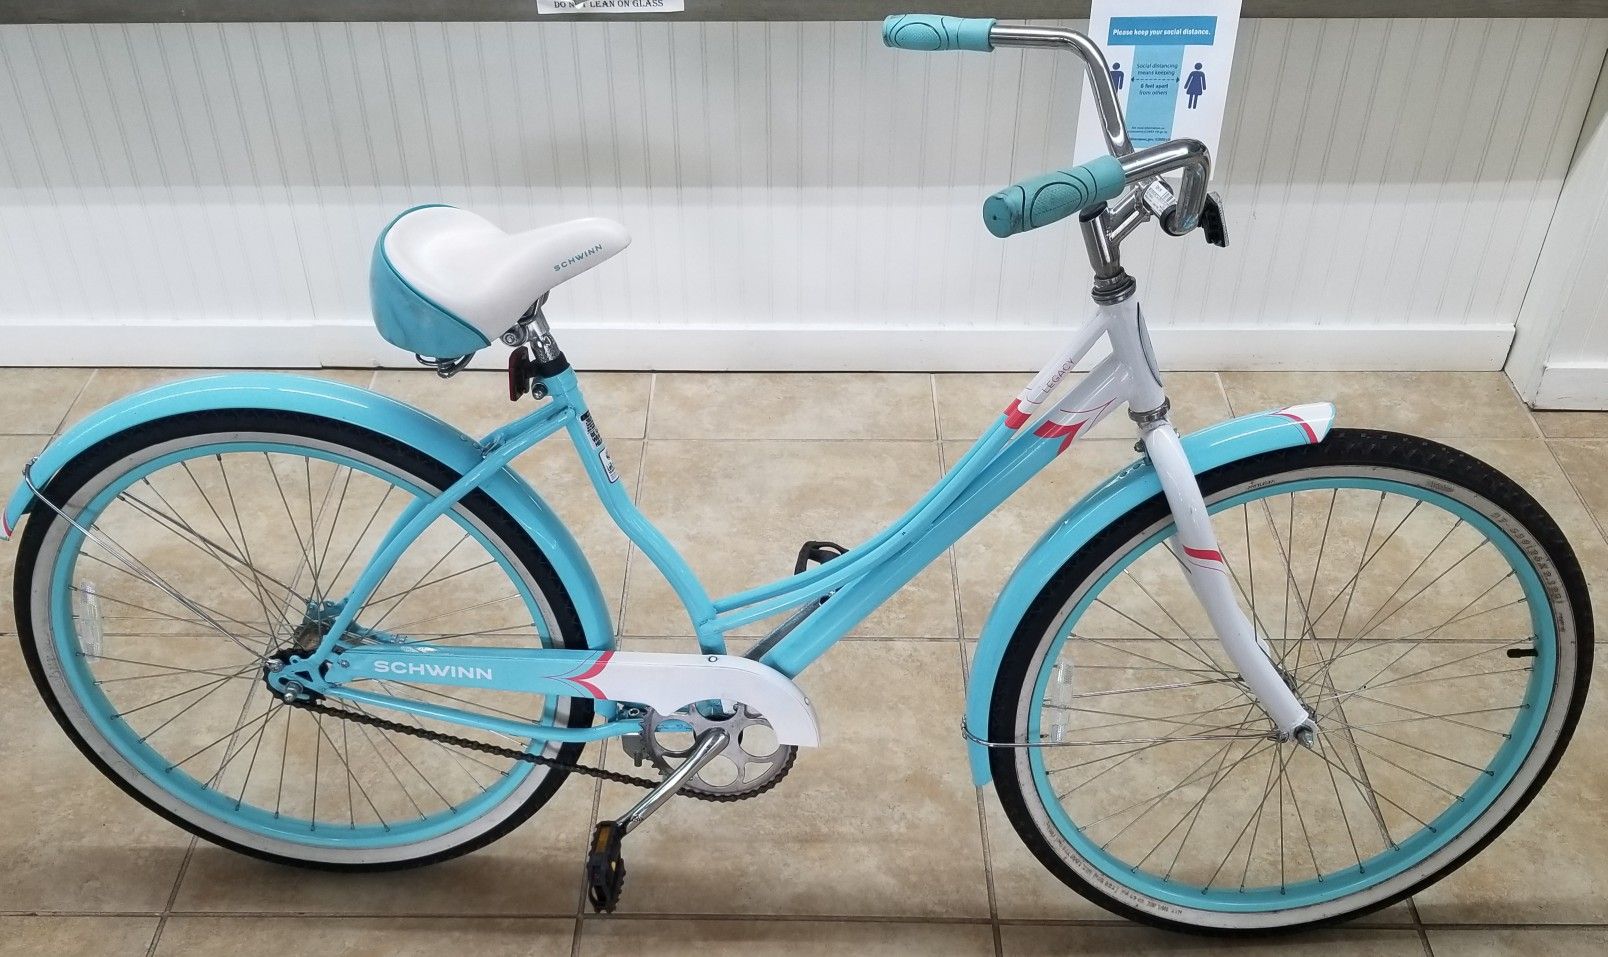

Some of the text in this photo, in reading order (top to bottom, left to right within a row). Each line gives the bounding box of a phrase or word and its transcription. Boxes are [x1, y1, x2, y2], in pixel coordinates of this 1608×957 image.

[590, 0, 615, 8] LEAN
[617, 0, 630, 8] ON
[1183, 28, 1211, 36] distance.
[553, 243, 603, 272] SCHWINN
[1041, 357, 1076, 393] LEGACY
[373, 660, 493, 680] SCHWINN
